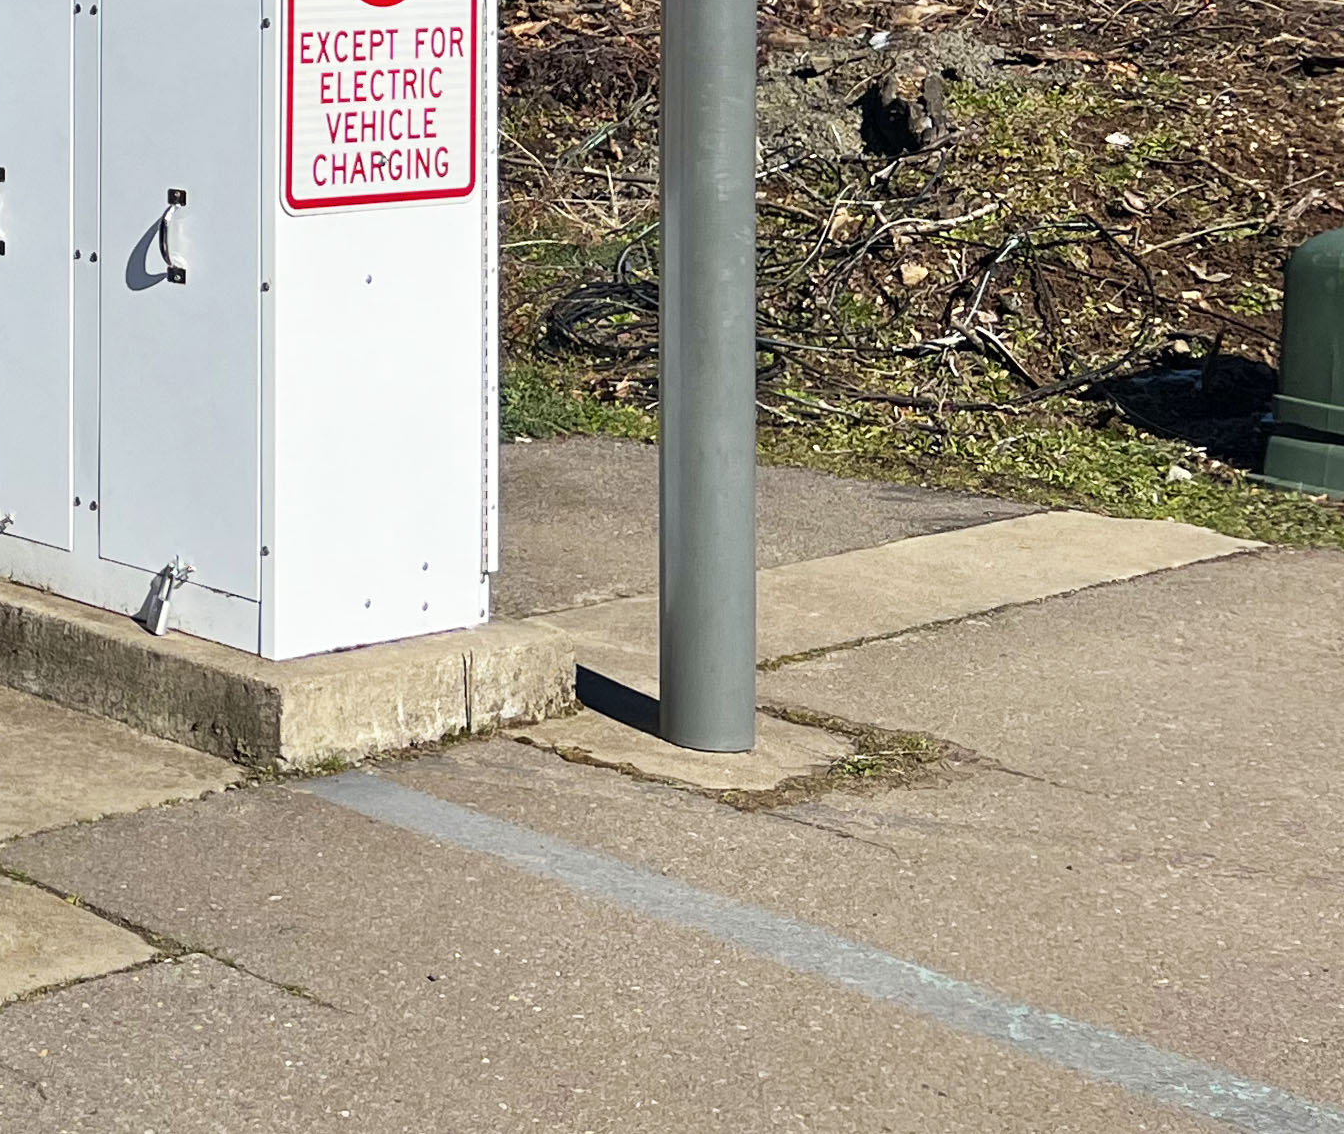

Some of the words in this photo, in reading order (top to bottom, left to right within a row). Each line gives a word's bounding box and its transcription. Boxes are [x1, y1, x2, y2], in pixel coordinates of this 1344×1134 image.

[300, 29, 399, 64] EXCEPT
[414, 27, 464, 58] FOR
[320, 68, 443, 104] ELECTRIC
[327, 107, 438, 143] VEHICLE
[313, 147, 449, 186] CHARGING
